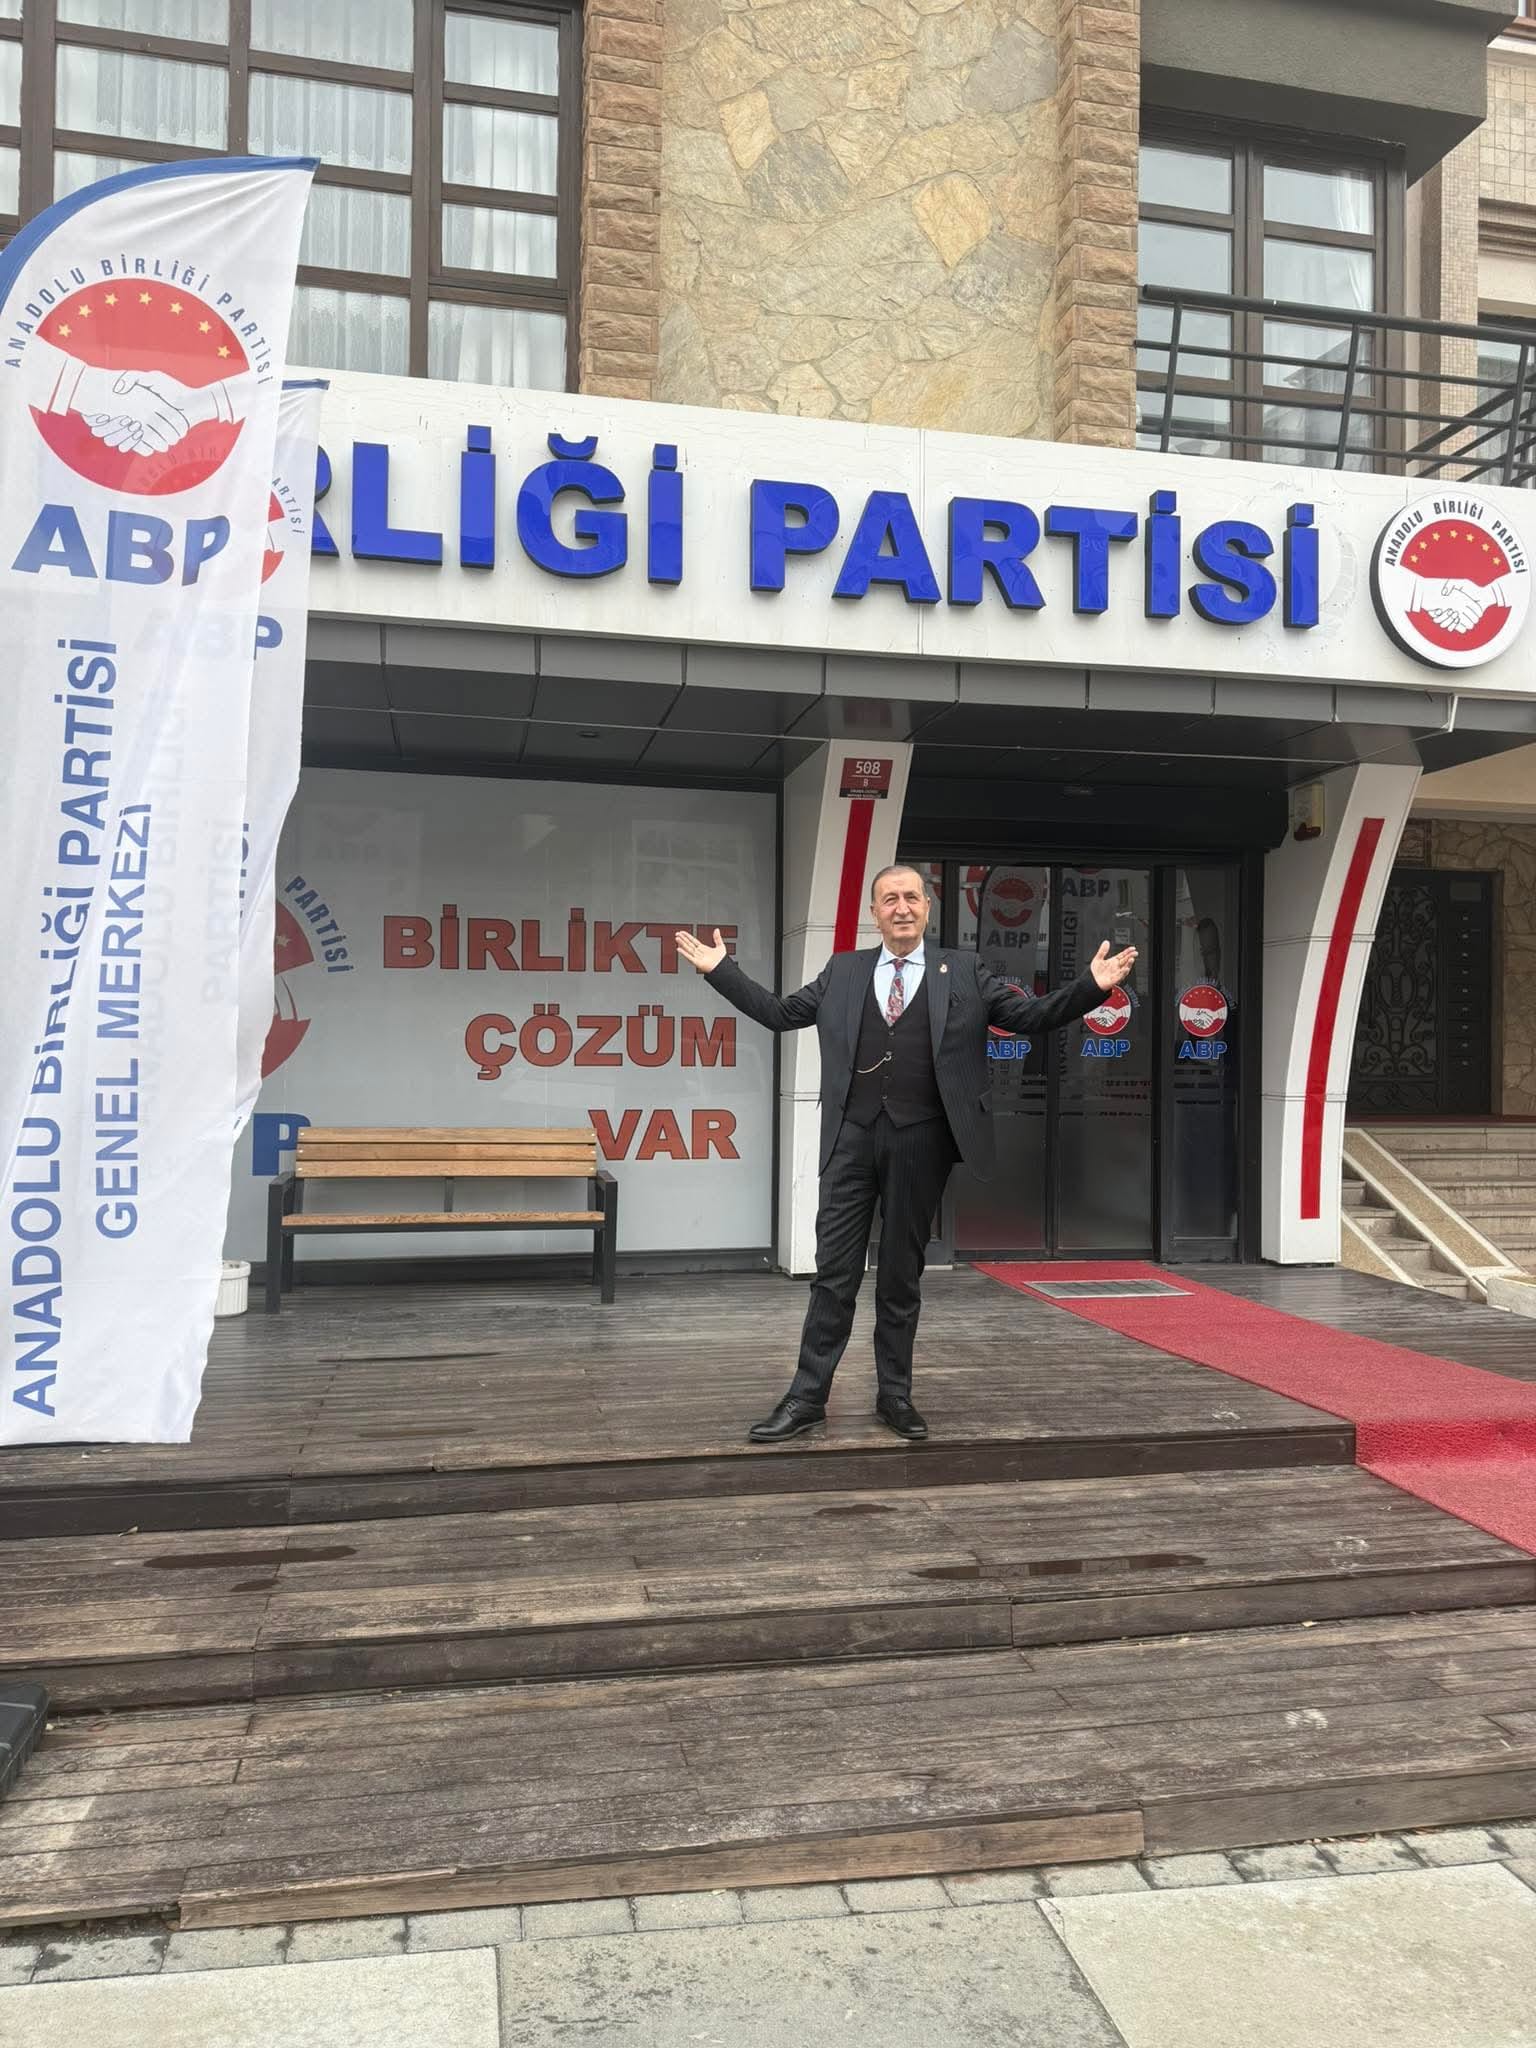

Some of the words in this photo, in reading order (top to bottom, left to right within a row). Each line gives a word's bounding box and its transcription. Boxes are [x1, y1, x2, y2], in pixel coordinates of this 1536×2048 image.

[5, 267, 86, 369] ANADOLU
[101, 253, 211, 292] BİRLİĞİ
[216, 292, 274, 385] PARTİSİ
[11, 503, 231, 587] ABP
[311, 425, 683, 585] LİĞİ
[750, 478, 1320, 630] PARTİSİ
[1385, 510, 1424, 567] ANADOLU
[1433, 498, 1484, 521] BİRLİĞİ
[1491, 519, 1528, 574] PARTİSİ
[54, 638, 117, 866] PARTİSİ
[855, 761, 881, 775] 508
[96, 803, 151, 1039] MERKEZİ
[284, 875, 355, 973] PARTİSİ
[31, 886, 95, 1095] BİRLİĞİ
[464, 1003, 737, 1081] ÇÖZÜM
[986, 1040, 1032, 1060] ABP
[1081, 1038, 1132, 1058] ABP
[1178, 1040, 1228, 1060] ABP
[95, 1058, 139, 1239] GENEL
[588, 1109, 741, 1160] VAR
[11, 1116, 63, 1417] ANADOLU
